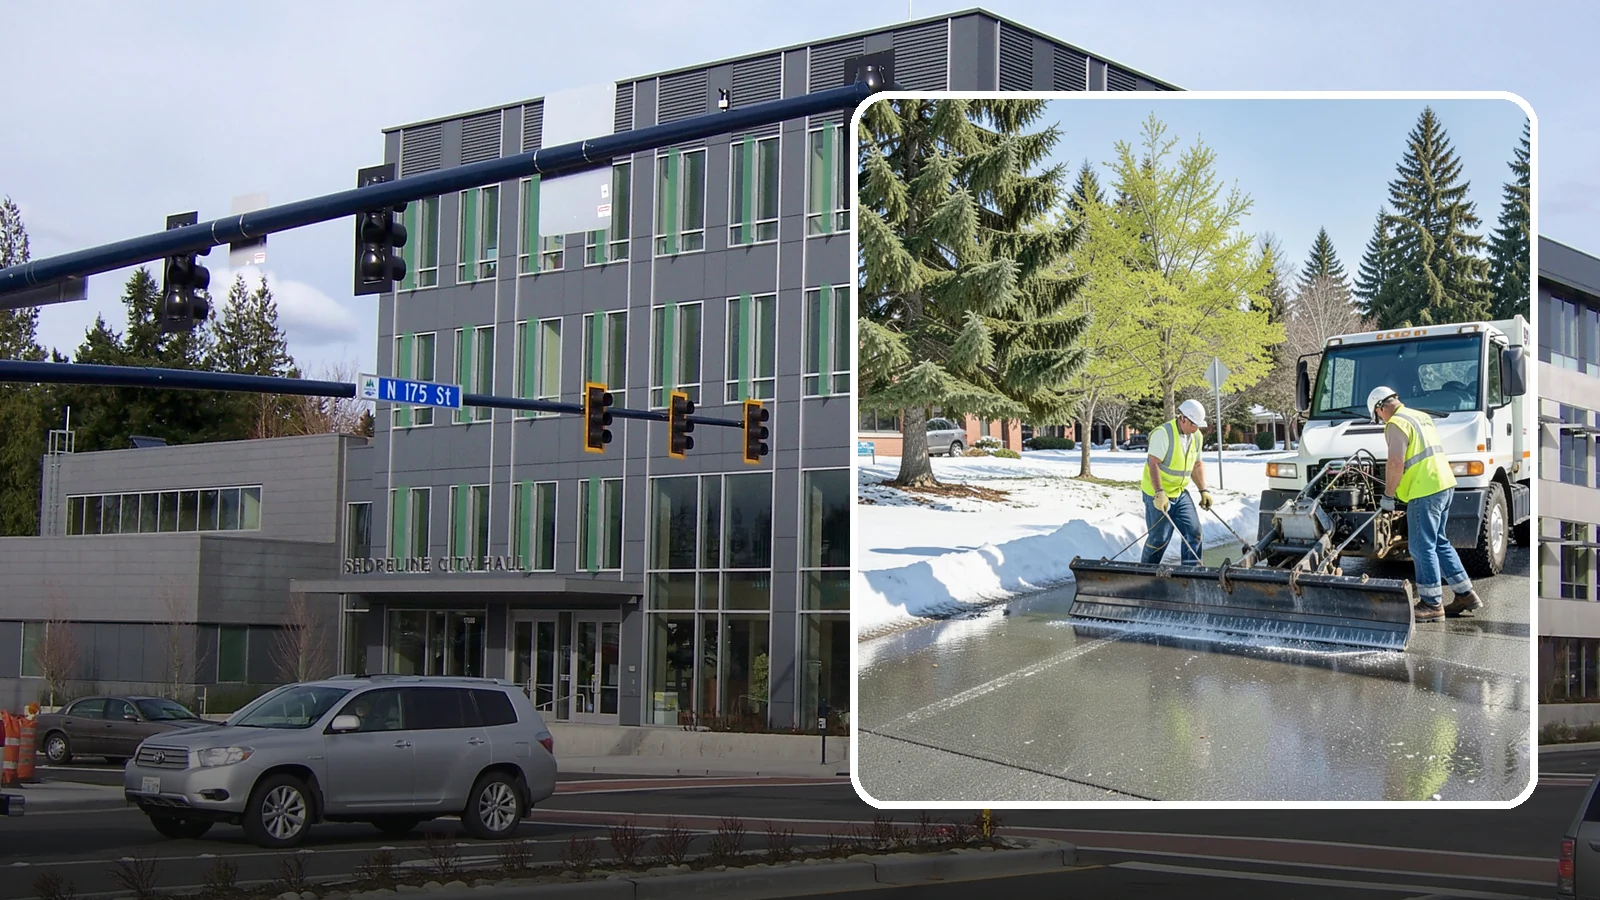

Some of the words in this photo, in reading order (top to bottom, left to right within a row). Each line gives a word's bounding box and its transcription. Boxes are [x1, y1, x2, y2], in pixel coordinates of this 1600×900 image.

[387, 380, 396, 400] N
[405, 382, 428, 403] 175
[436, 386, 452, 406] St
[344, 556, 432, 574] SHORELINE
[438, 555, 477, 573] CITY
[483, 555, 526, 572] HALL
